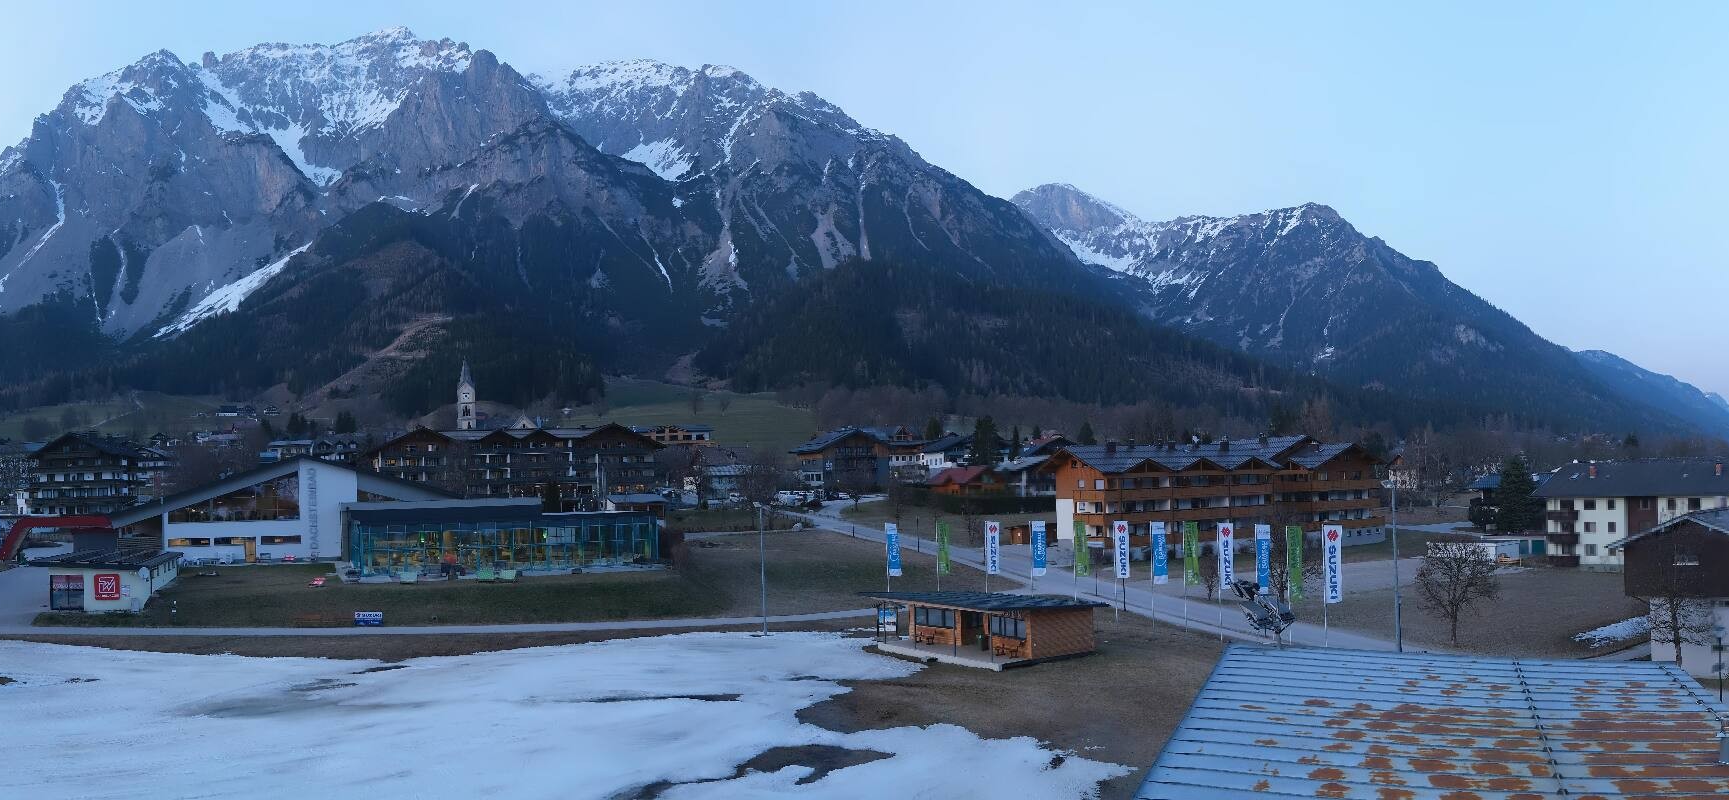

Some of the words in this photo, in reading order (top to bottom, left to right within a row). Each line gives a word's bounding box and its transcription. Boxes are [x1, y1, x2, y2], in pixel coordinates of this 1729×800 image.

[306, 467, 319, 549] DACHSTEINBAD
[1119, 536, 1127, 576] SUZUKI
[1223, 540, 1232, 586] SUZUKI
[1328, 545, 1338, 600] SUZUKI
